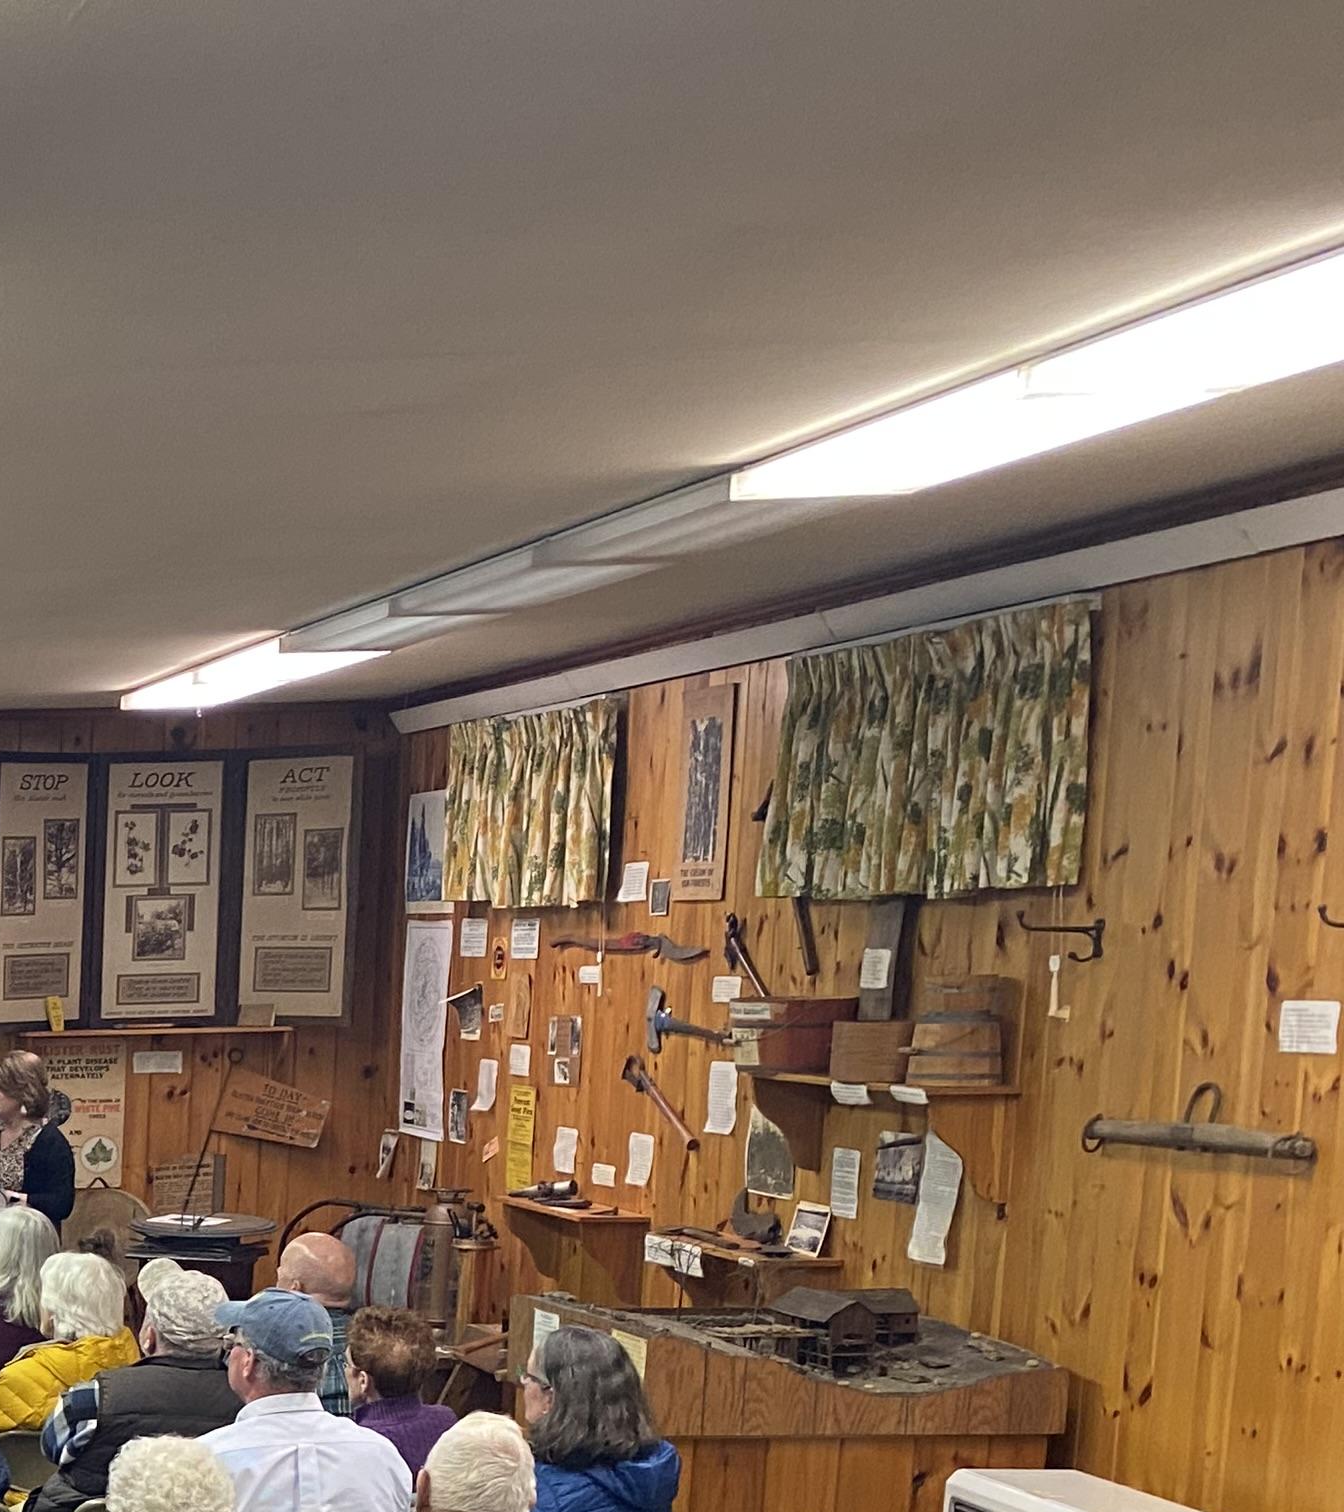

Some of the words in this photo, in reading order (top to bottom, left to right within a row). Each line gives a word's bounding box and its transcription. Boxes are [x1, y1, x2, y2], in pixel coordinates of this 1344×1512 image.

[19, 774, 69, 791] STOP
[128, 771, 196, 788] LOOK
[279, 766, 330, 784] ACT
[46, 1065, 66, 1073] THAT
[69, 1065, 110, 1073] DEVELOPS
[85, 1057, 118, 1065] DISEASE
